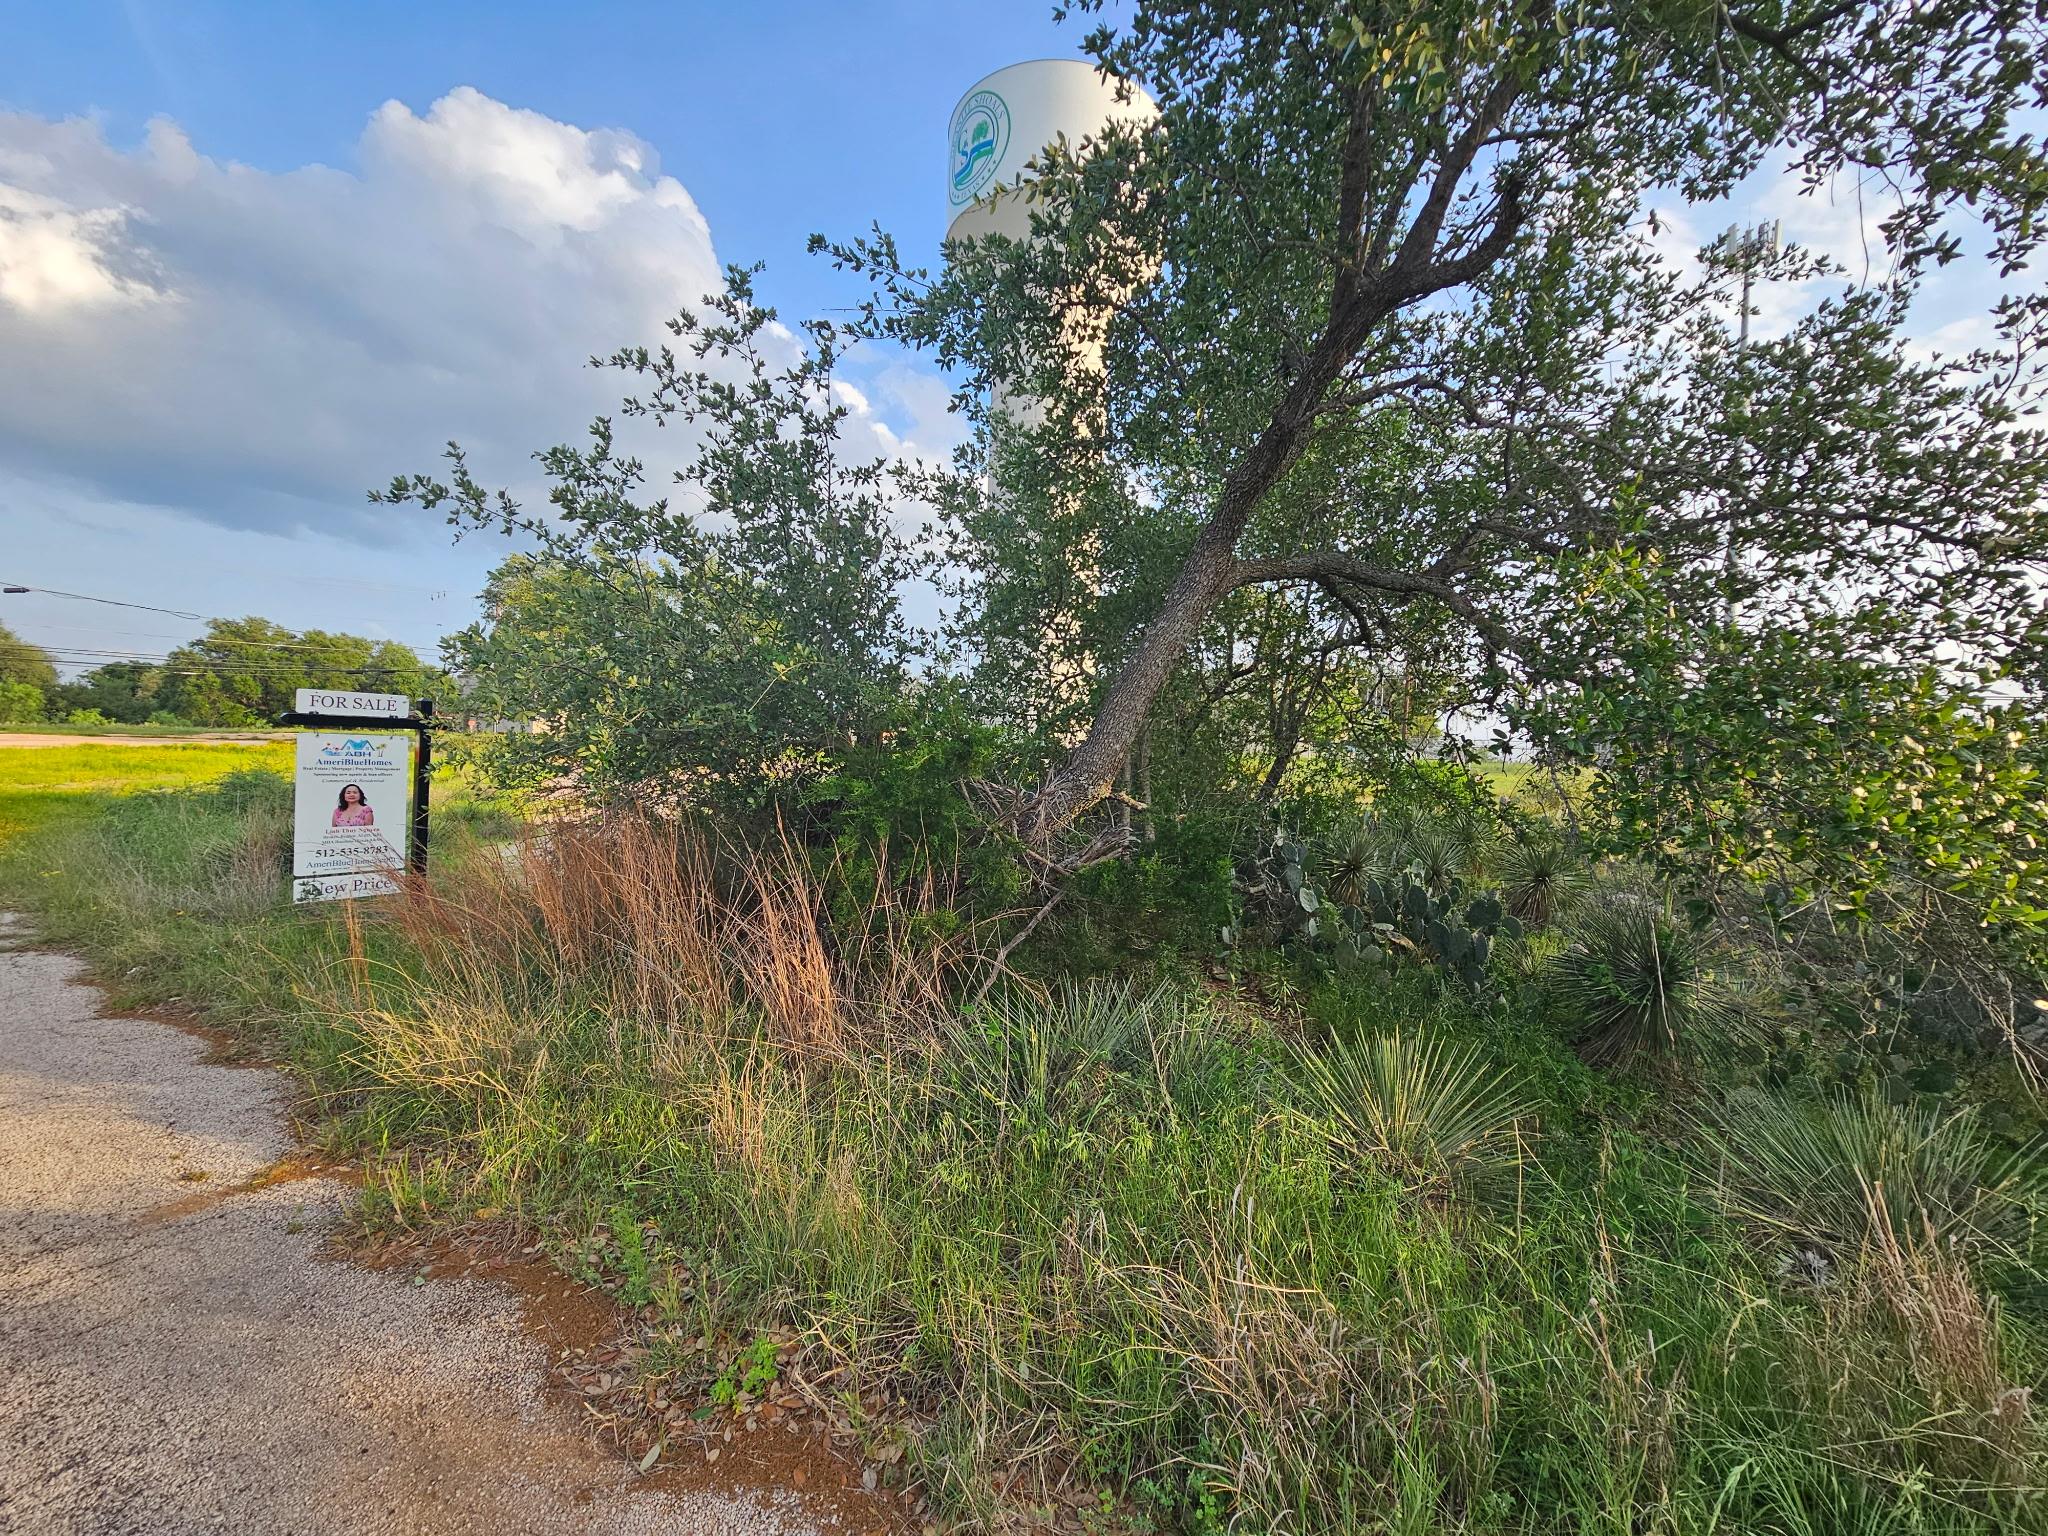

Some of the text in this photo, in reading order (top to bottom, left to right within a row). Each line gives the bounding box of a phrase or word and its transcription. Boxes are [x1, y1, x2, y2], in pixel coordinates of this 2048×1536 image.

[310, 694, 398, 712] FOR SALE
[316, 758, 393, 766] AmeriBlueHomes
[315, 845, 389, 858] 512-535-8783
[352, 877, 392, 892] Price
